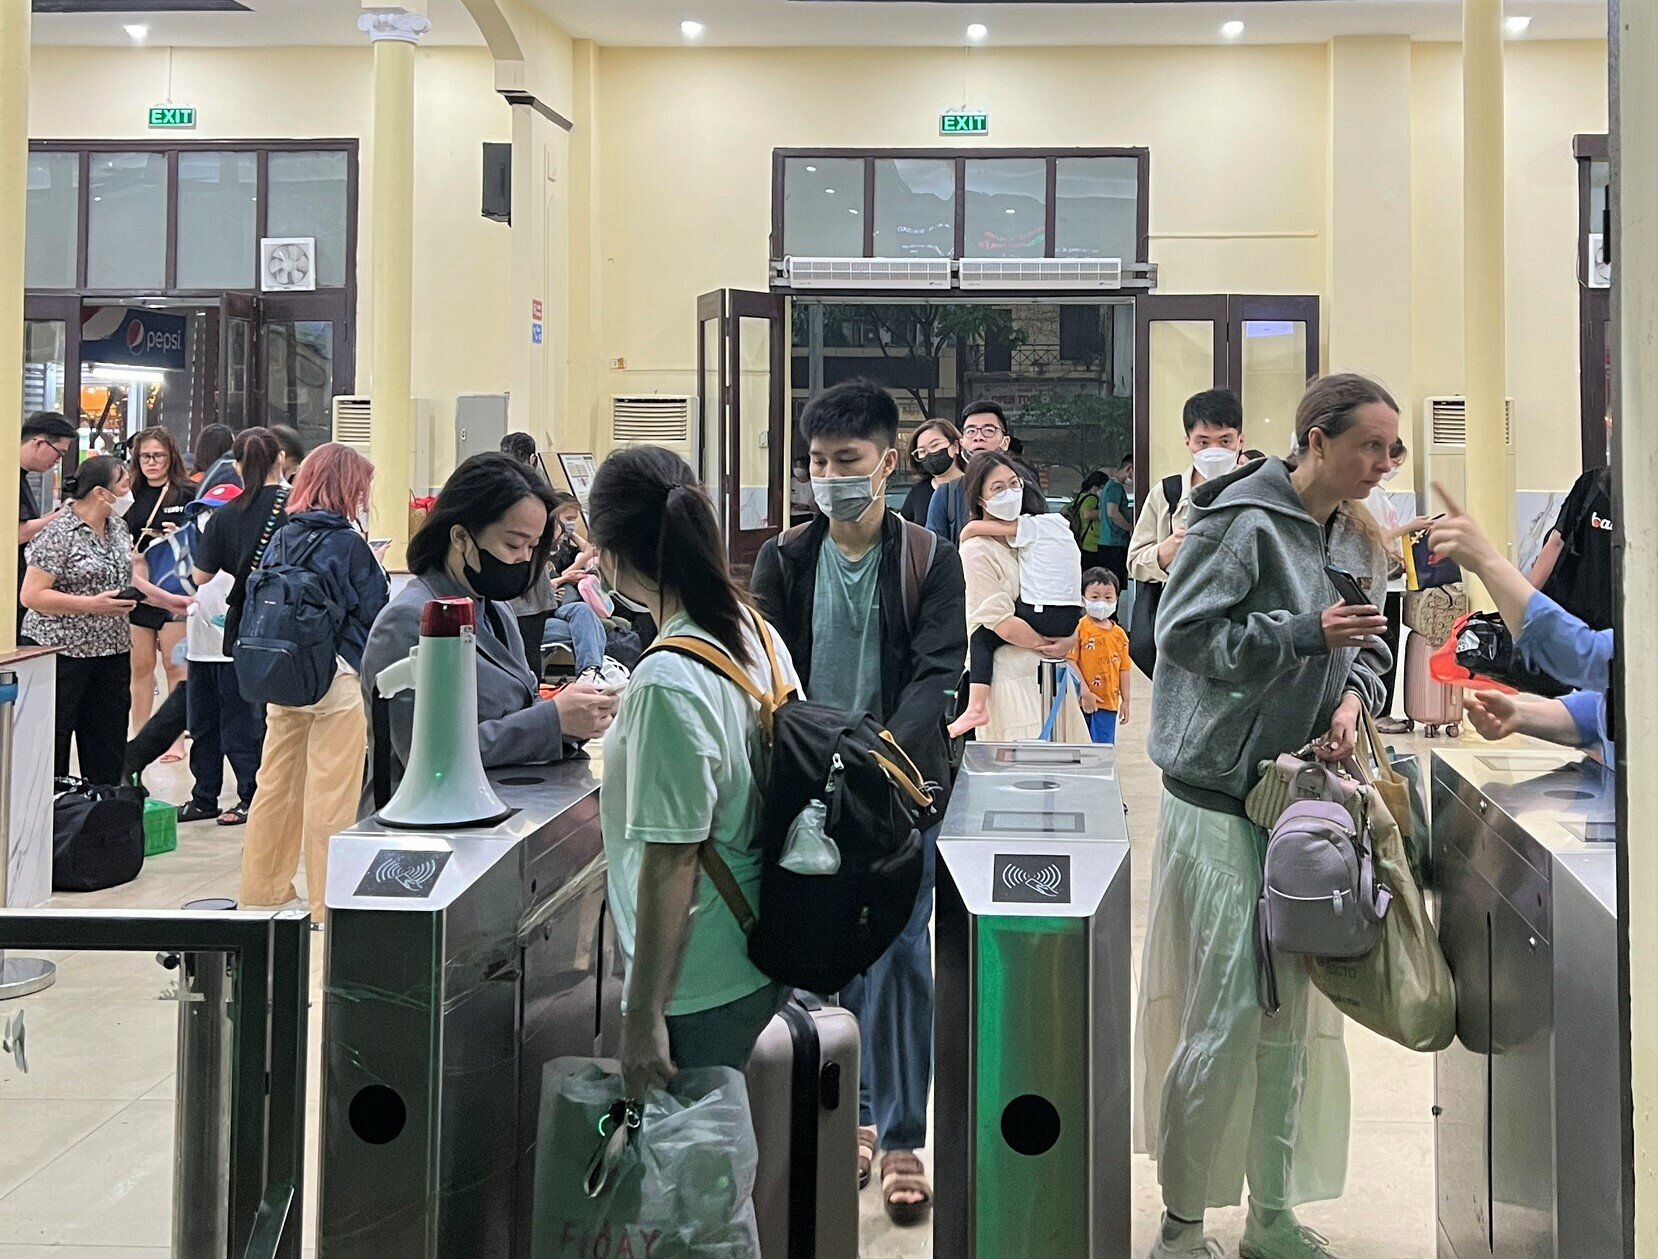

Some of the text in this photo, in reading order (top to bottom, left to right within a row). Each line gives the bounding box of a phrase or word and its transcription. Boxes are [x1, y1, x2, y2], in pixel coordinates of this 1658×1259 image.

[151, 109, 192, 124] EXIT
[944, 116, 985, 130] EXIT
[147, 329, 182, 354] pepsi
